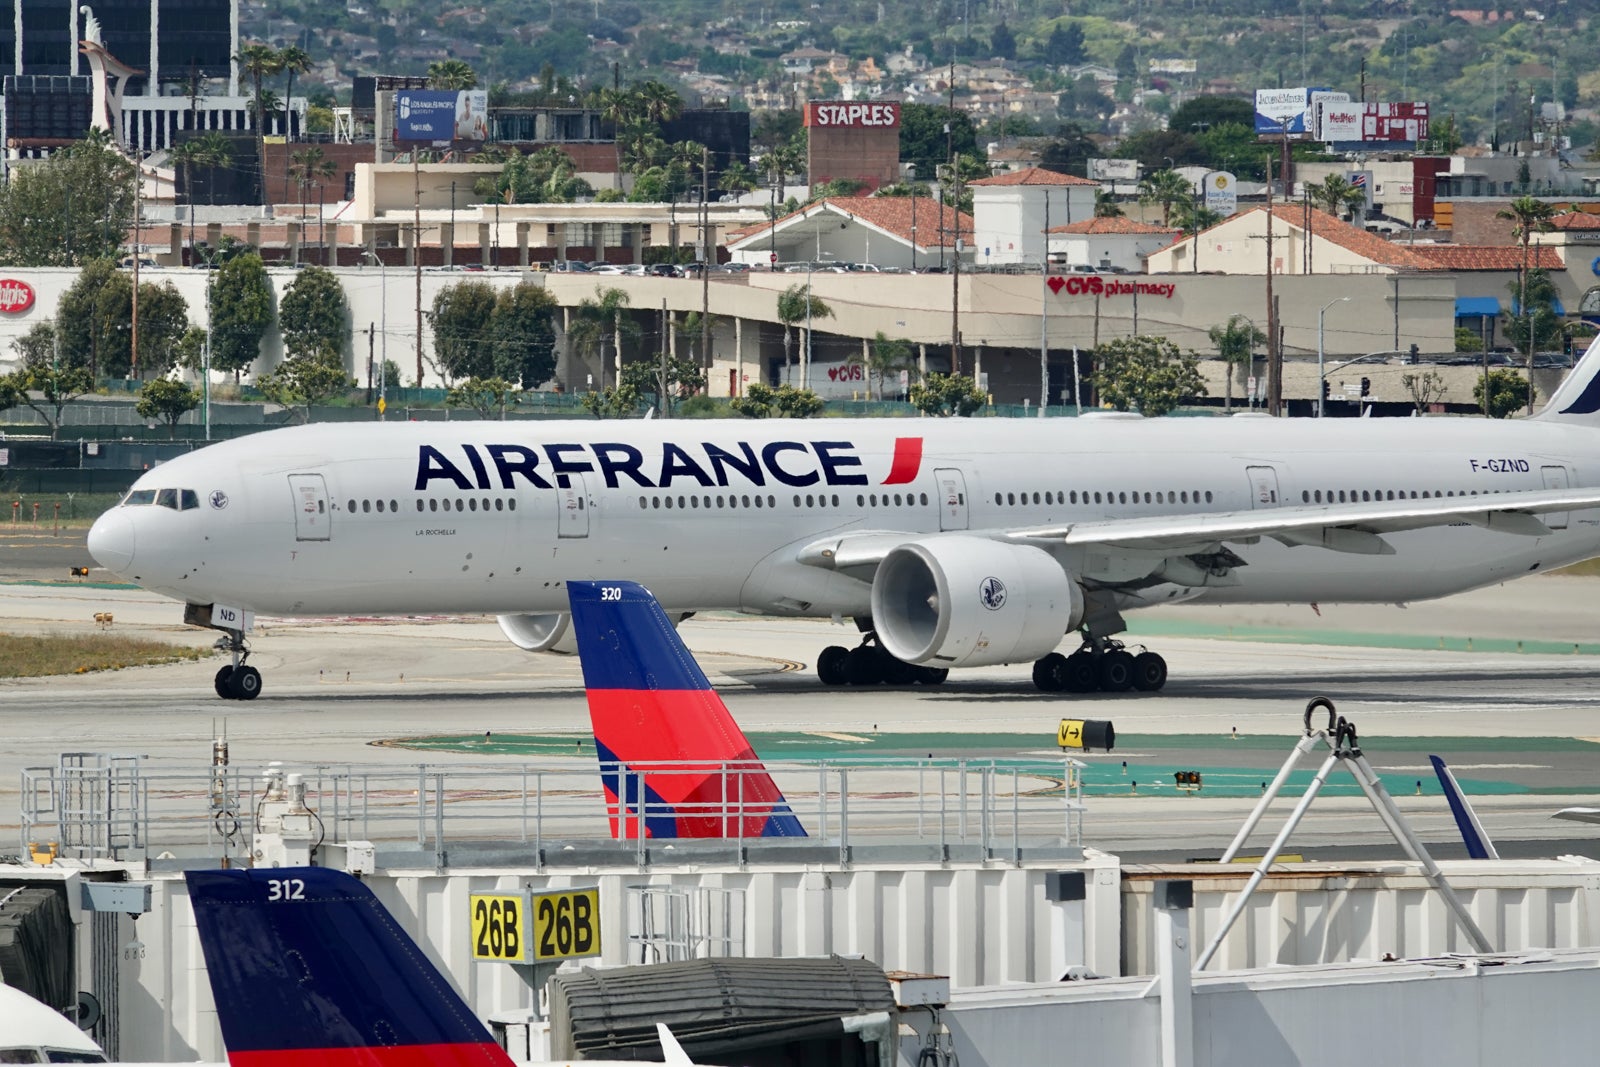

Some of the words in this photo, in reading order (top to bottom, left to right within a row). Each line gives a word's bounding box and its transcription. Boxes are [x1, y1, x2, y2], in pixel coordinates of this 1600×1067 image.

[817, 105, 895, 126] STAPLES
[1066, 276, 1103, 295] CVS
[1105, 280, 1175, 299] pharmacy
[839, 365, 861, 382] CVS
[1469, 459, 1530, 473] F-GZND
[601, 587, 621, 601] 320
[220, 608, 236, 622] ND
[1061, 724, 1070, 741] V
[268, 879, 305, 901] 312
[475, 899, 519, 958] 26B
[538, 894, 592, 955] 26B
